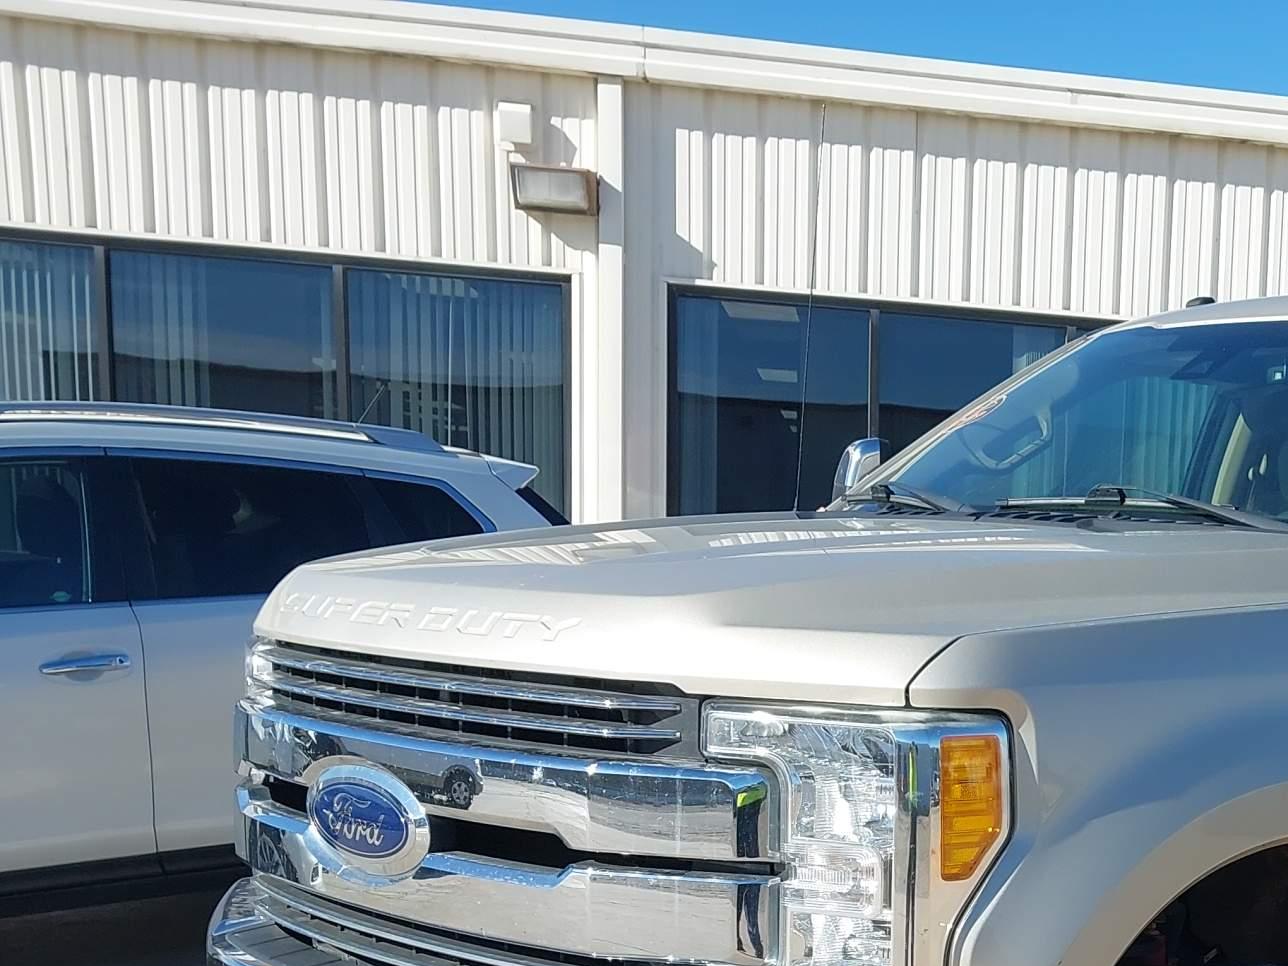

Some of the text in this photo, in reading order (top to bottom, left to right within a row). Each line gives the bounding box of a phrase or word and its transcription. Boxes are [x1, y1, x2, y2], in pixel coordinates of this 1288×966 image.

[280, 592, 583, 642] SUPER DUTY
[322, 792, 385, 846] Ford
